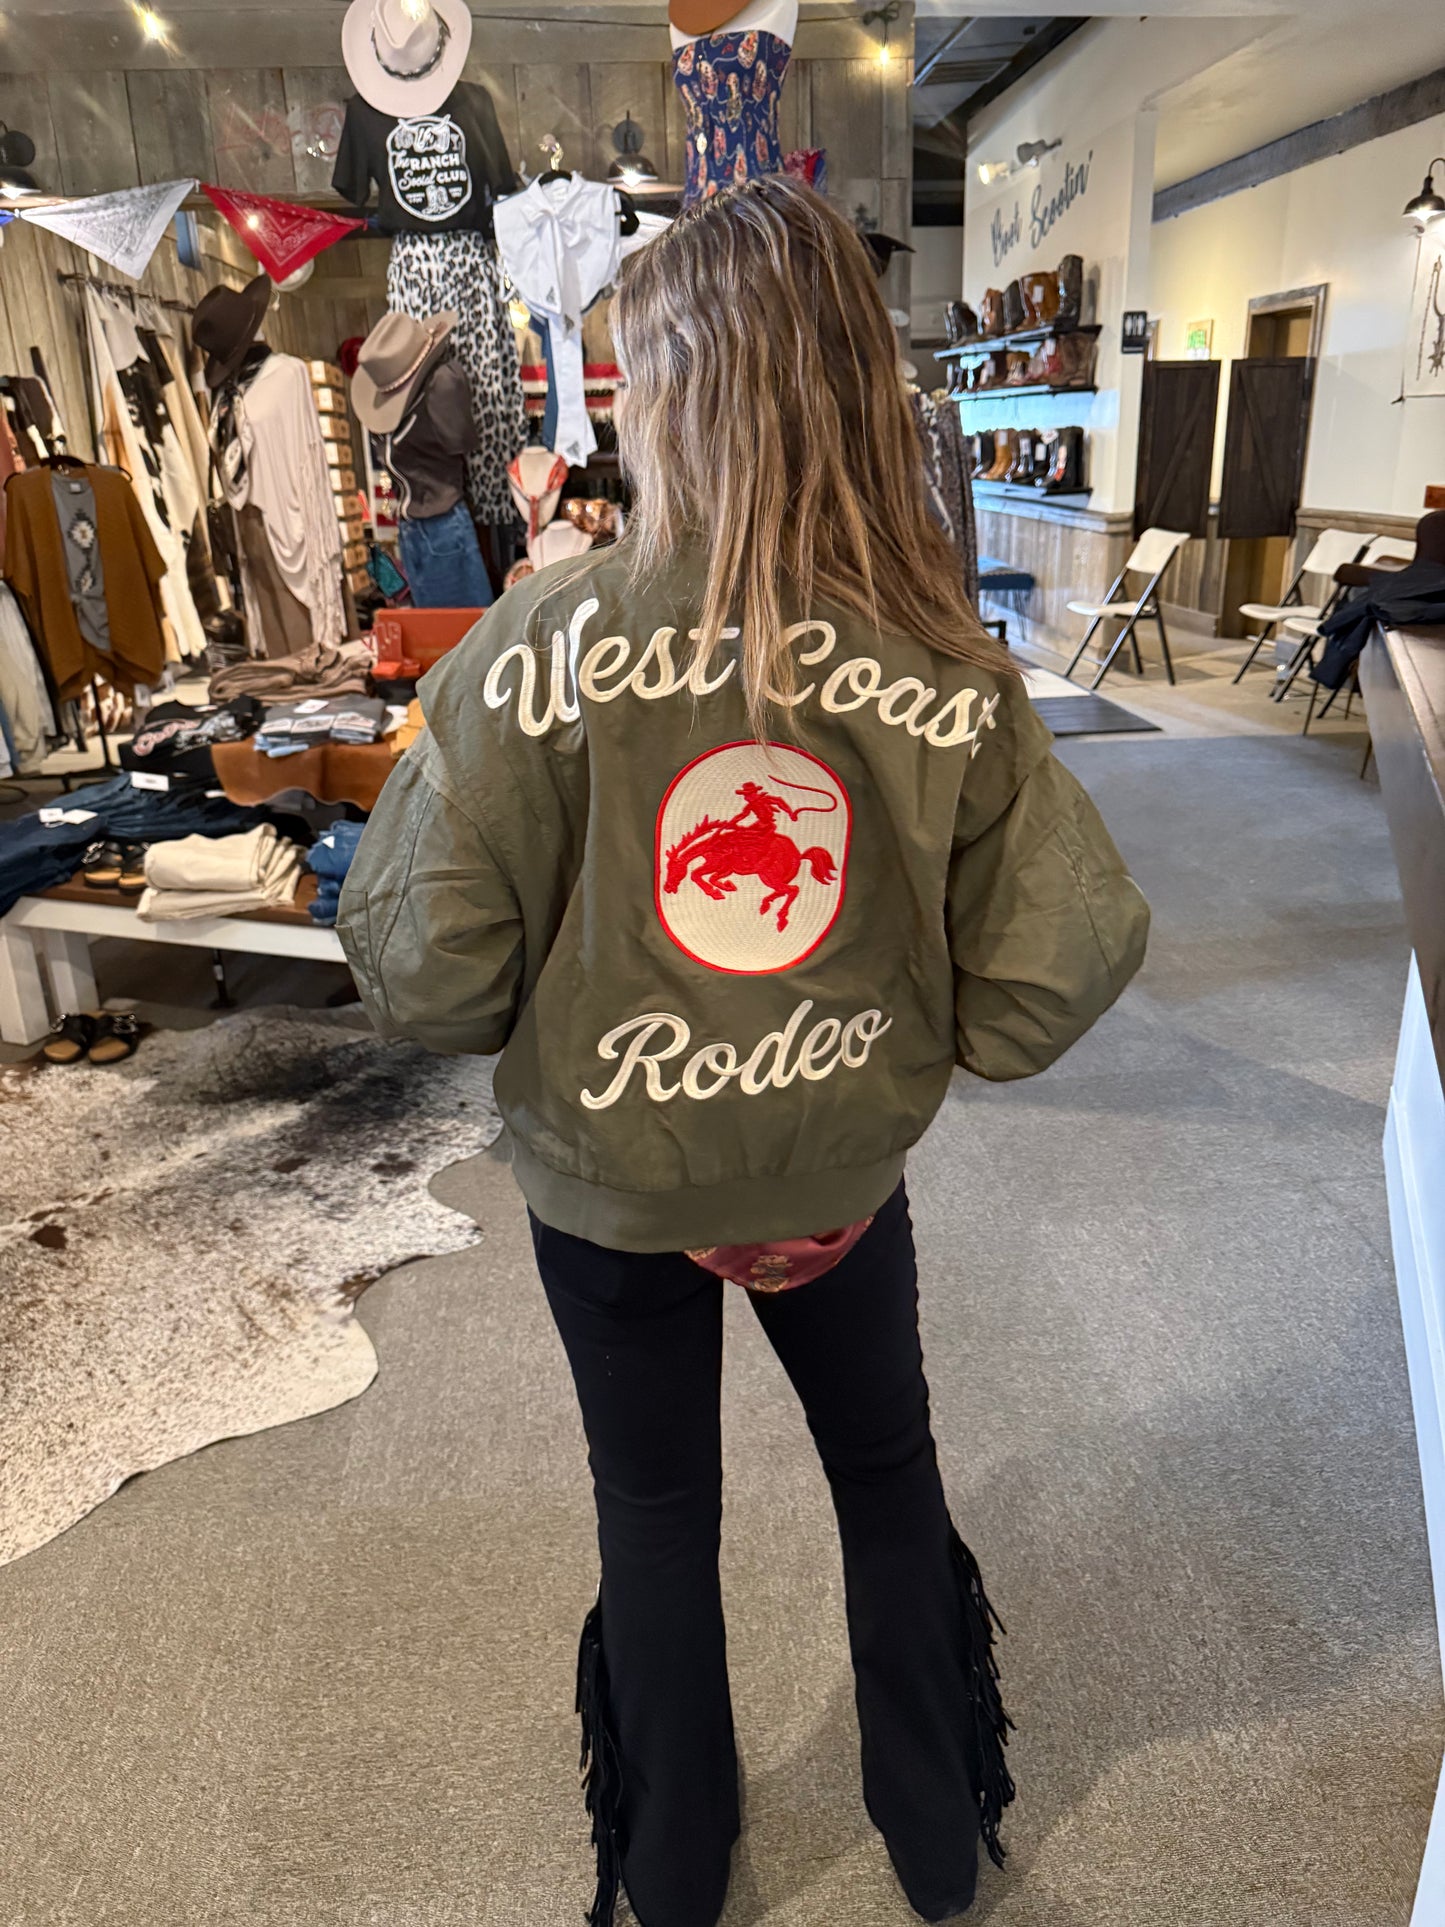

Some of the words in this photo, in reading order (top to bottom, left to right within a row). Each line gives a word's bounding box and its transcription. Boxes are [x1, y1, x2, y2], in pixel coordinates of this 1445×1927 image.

[398, 168, 437, 190] Social
[436, 169, 467, 183] CLUB
[410, 153, 460, 171] RANCH
[483, 598, 740, 738] West
[757, 619, 1001, 759] Coast
[580, 999, 893, 1110] Rodeo
